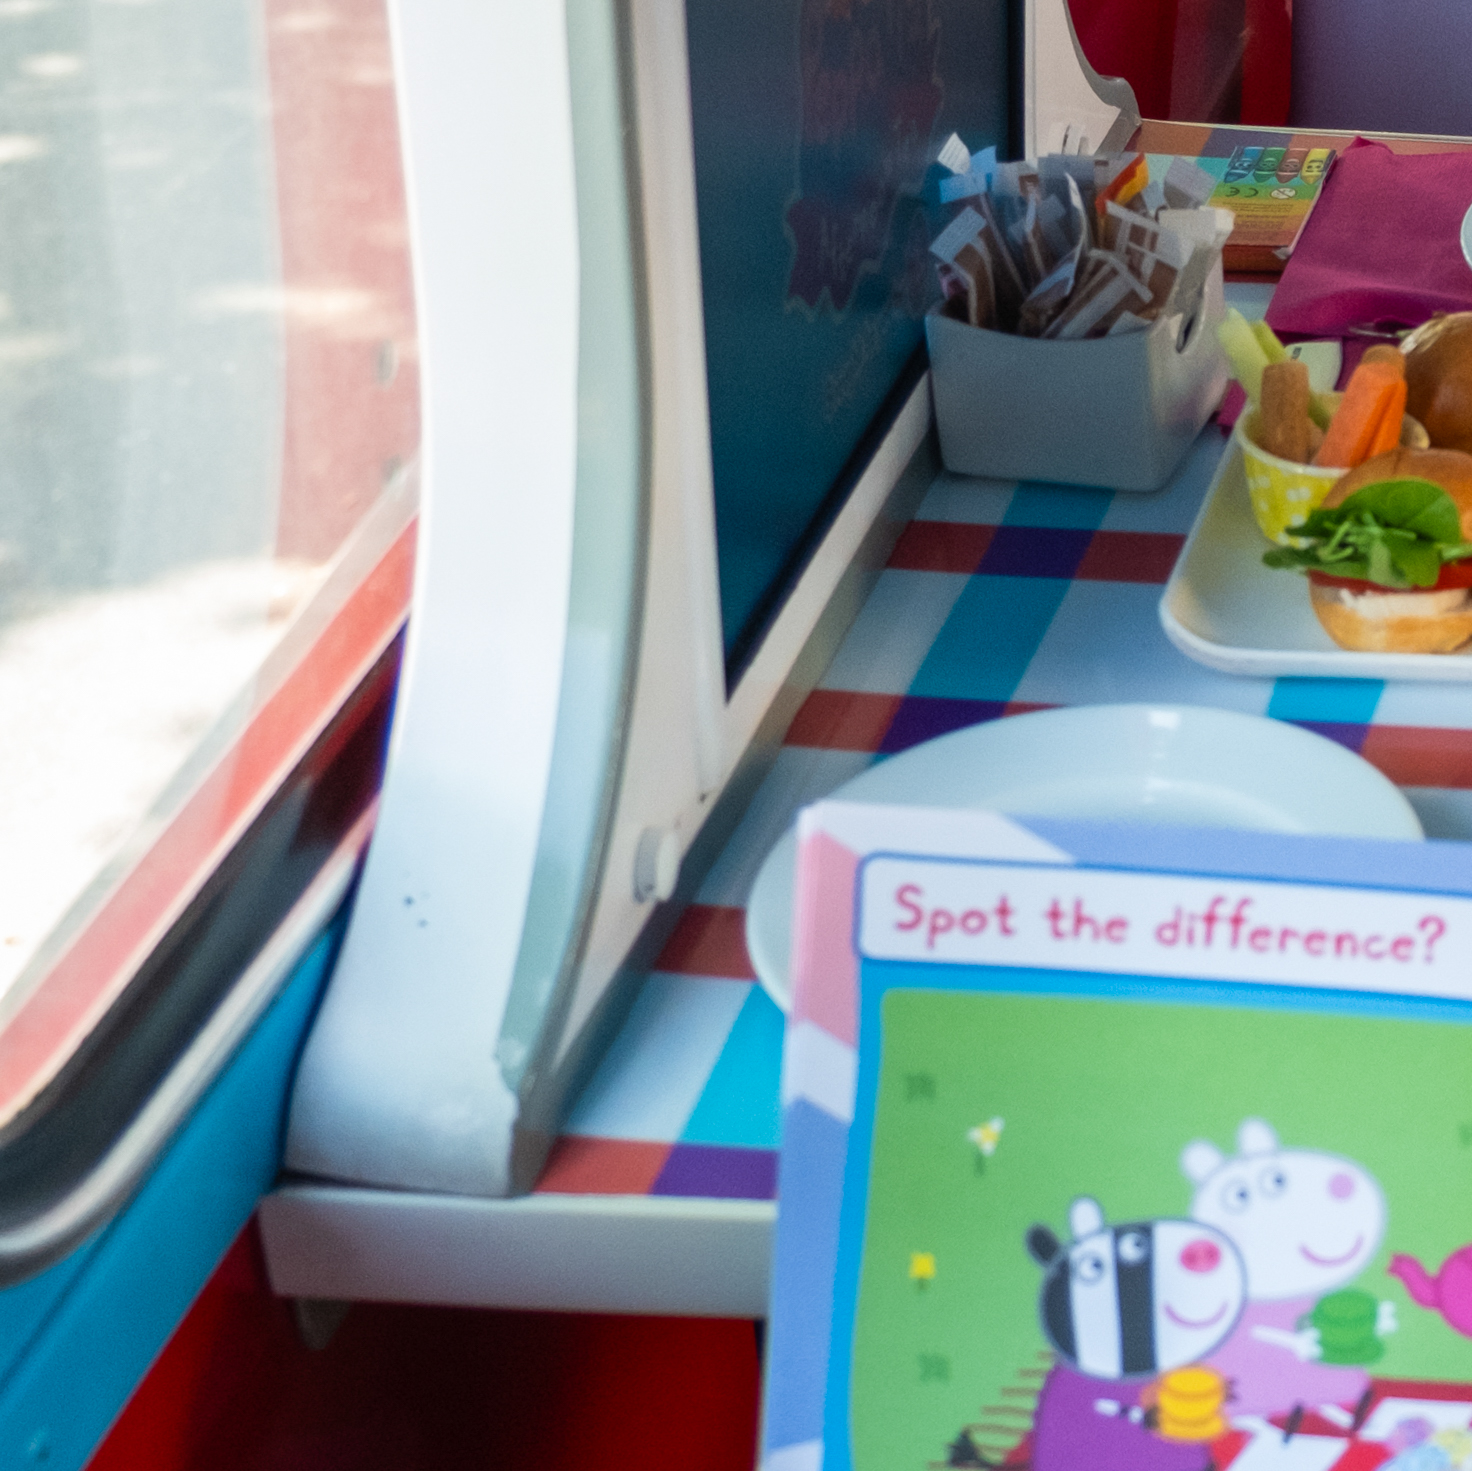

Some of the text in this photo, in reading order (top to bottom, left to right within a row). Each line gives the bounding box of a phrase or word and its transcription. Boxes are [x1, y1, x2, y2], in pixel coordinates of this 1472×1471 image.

[894, 882, 1447, 964] Spot the difference?
